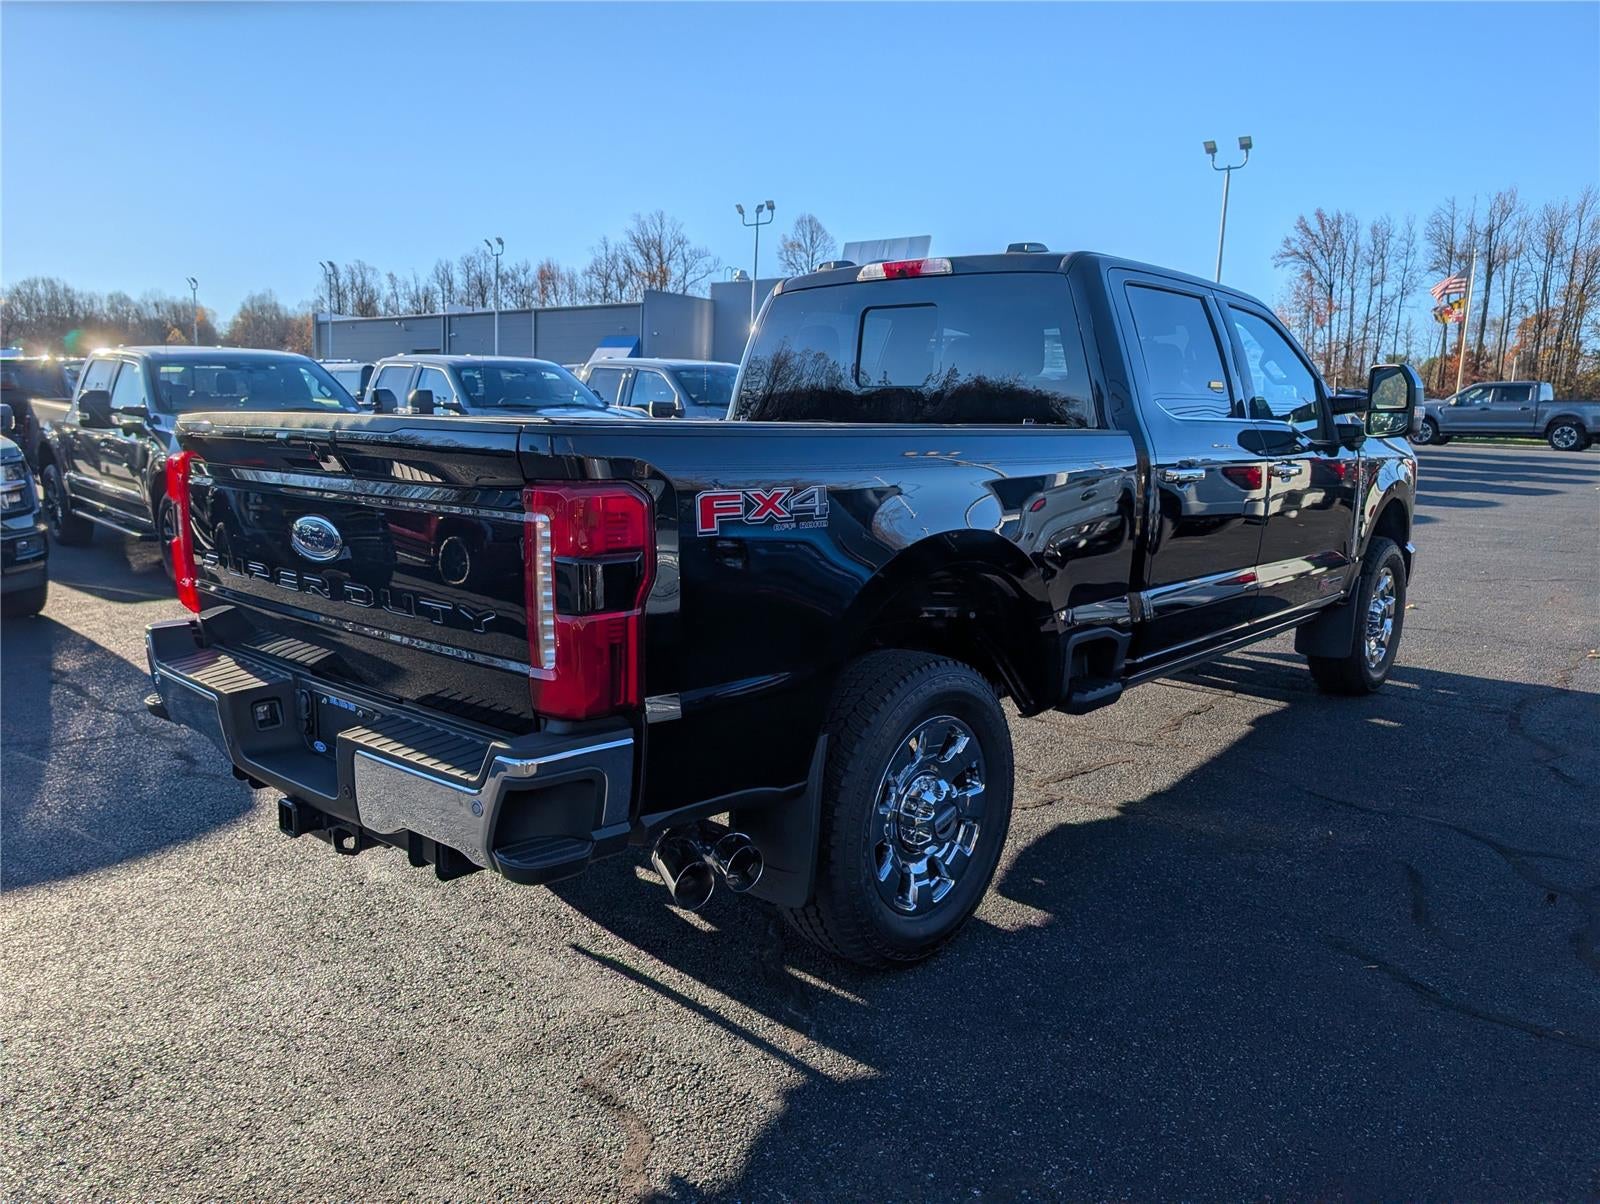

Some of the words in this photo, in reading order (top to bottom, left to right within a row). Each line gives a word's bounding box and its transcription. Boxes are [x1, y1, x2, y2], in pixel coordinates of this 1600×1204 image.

[697, 486, 828, 536] FX4
[202, 553, 331, 599] SUPER
[344, 583, 497, 633] DUTY
